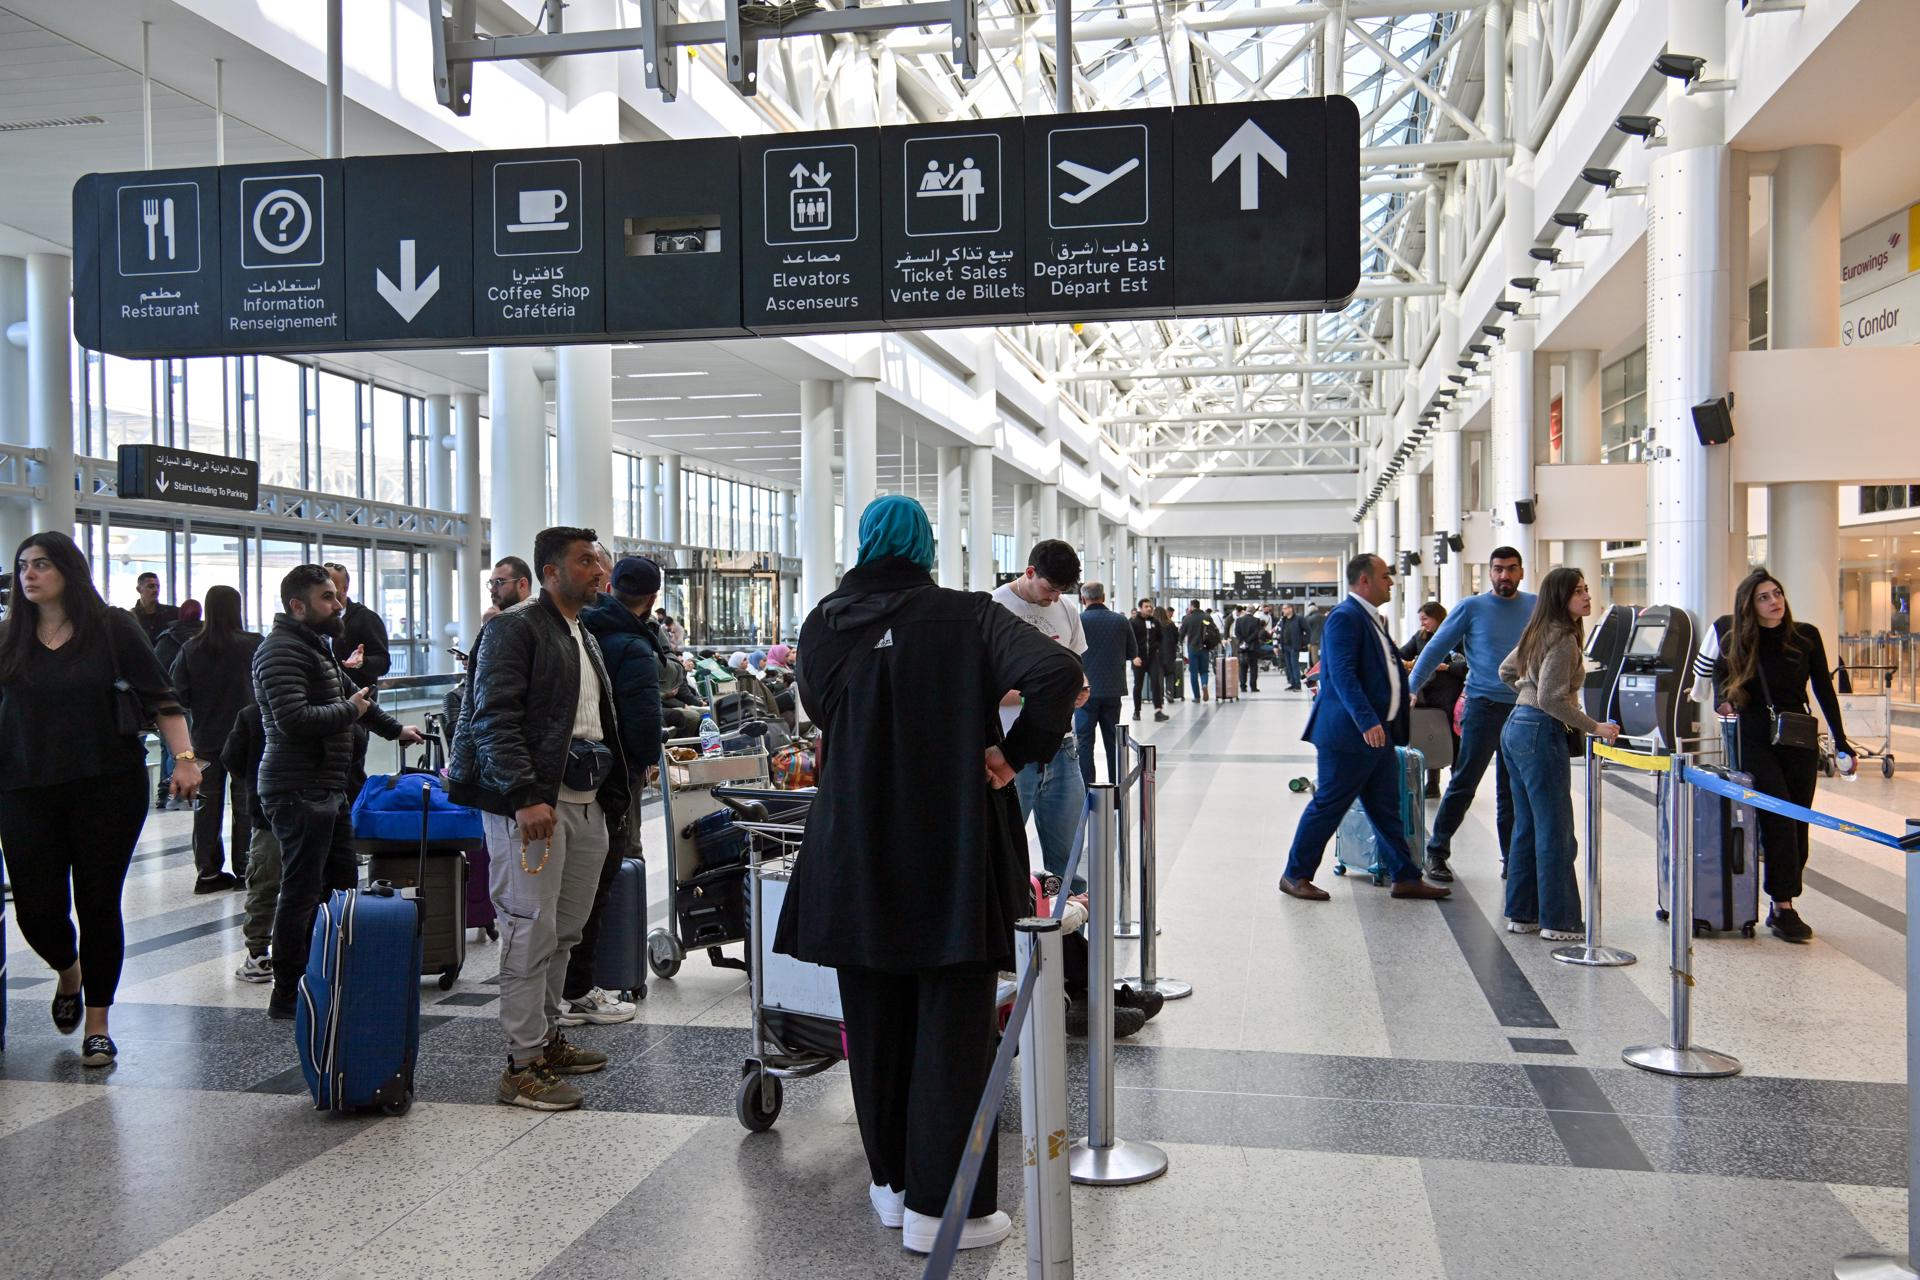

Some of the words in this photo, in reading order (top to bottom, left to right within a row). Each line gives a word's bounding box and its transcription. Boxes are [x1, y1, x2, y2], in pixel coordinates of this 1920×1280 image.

[942, 246, 983, 266] تذاكر
[987, 249, 1014, 264] بيع
[1102, 238, 1149, 257] ذهاب
[782, 250, 841, 264] مصاعد
[893, 248, 940, 268] السفر
[1842, 250, 1889, 282] Eurowings
[512, 266, 564, 286] كافتيريا
[901, 266, 954, 283] Ticket
[960, 265, 1007, 280] Sales
[1034, 259, 1120, 279] Departure
[1127, 256, 1166, 272] East
[247, 278, 320, 294] استعلامات
[773, 271, 850, 288] Elevators
[1051, 279, 1111, 298] Départ
[1121, 276, 1148, 293] Est
[139, 287, 182, 304] مطعم
[487, 286, 543, 302] Coffee
[551, 284, 590, 301] Shop
[890, 287, 940, 303] Vente
[946, 285, 967, 300] de
[973, 283, 1026, 299] Billets
[121, 301, 200, 318] Restaurant
[243, 296, 325, 312] Information
[502, 302, 576, 319] Cafétéria
[766, 296, 859, 312] Ascenseurs
[229, 313, 338, 332] Renseignement
[1857, 308, 1900, 339] Condor
[156, 455, 179, 467] السيارات
[174, 481, 193, 492] Stairs
[193, 484, 217, 497] Leading
[218, 487, 226, 496] To
[226, 488, 249, 501] Parking
